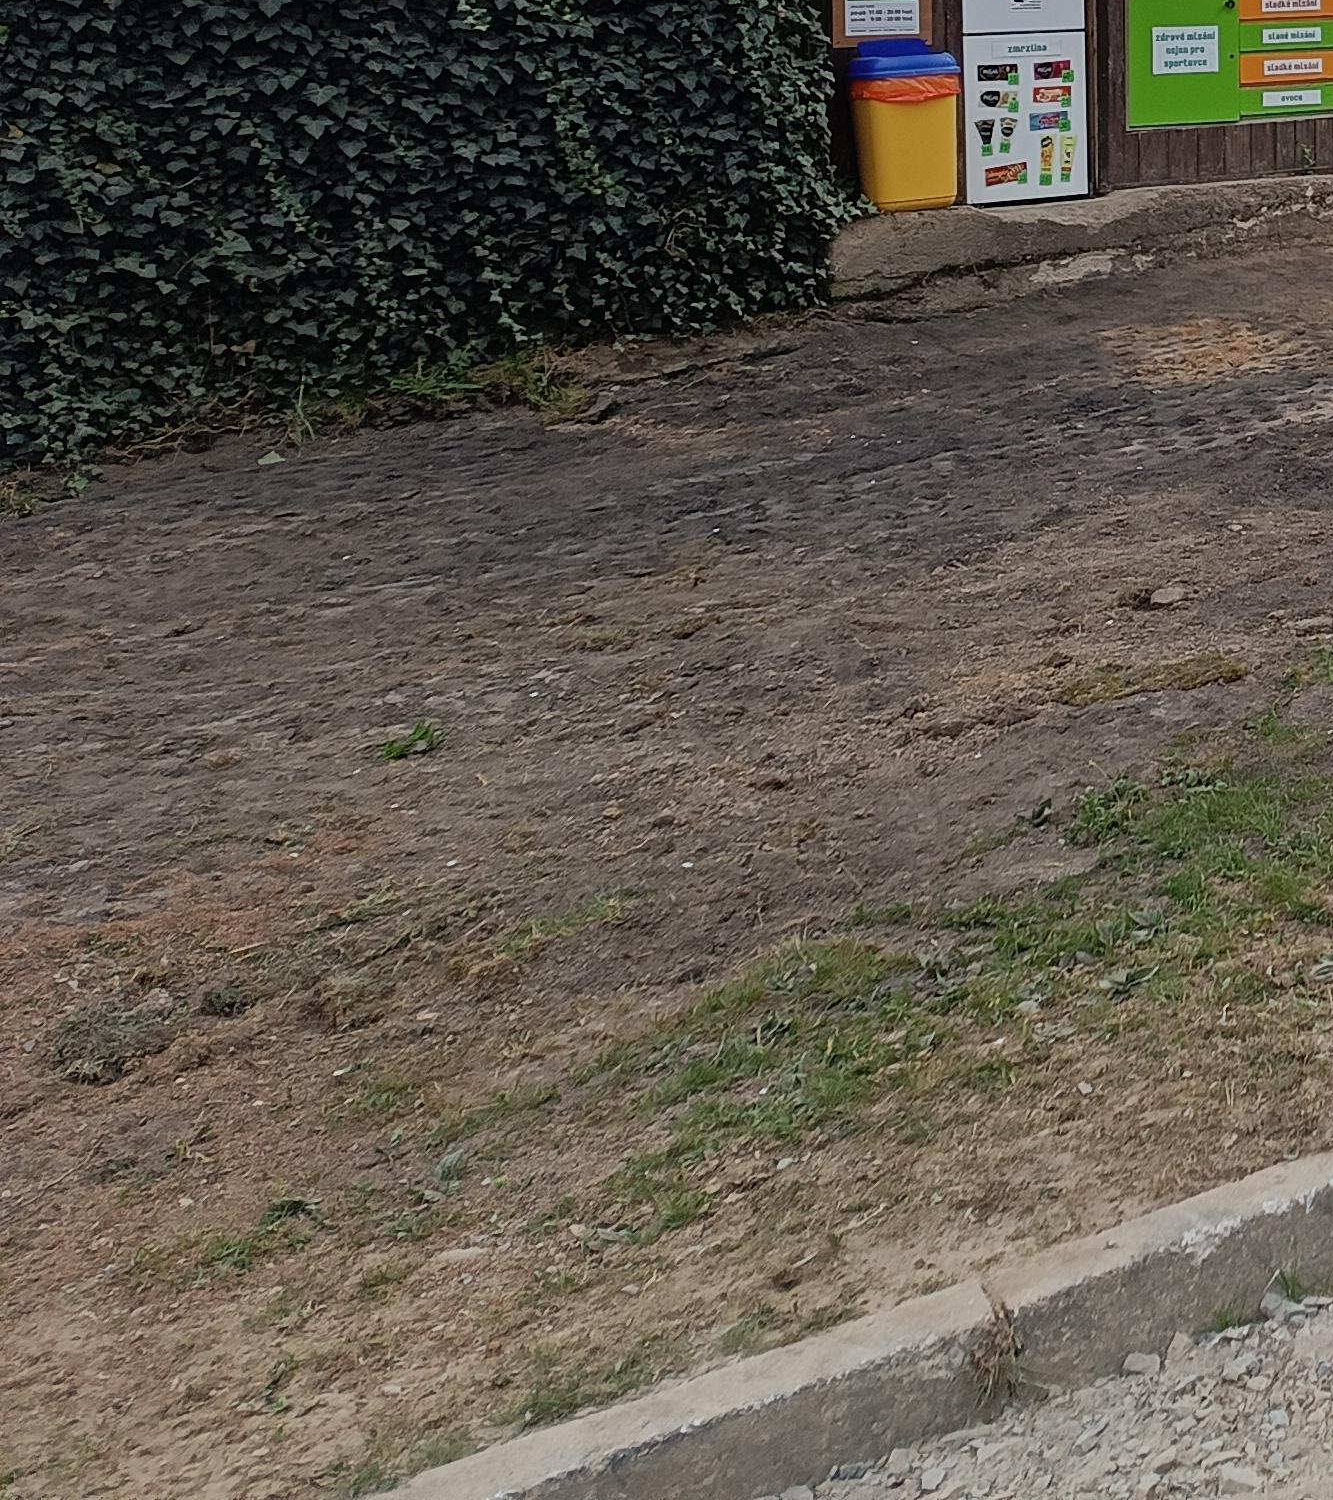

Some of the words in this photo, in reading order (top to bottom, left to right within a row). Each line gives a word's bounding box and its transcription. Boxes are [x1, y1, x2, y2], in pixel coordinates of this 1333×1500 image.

[1265, 0, 1291, 9] sladké
[1190, 46, 1205, 55] pro
[1266, 62, 1292, 72] sladké
